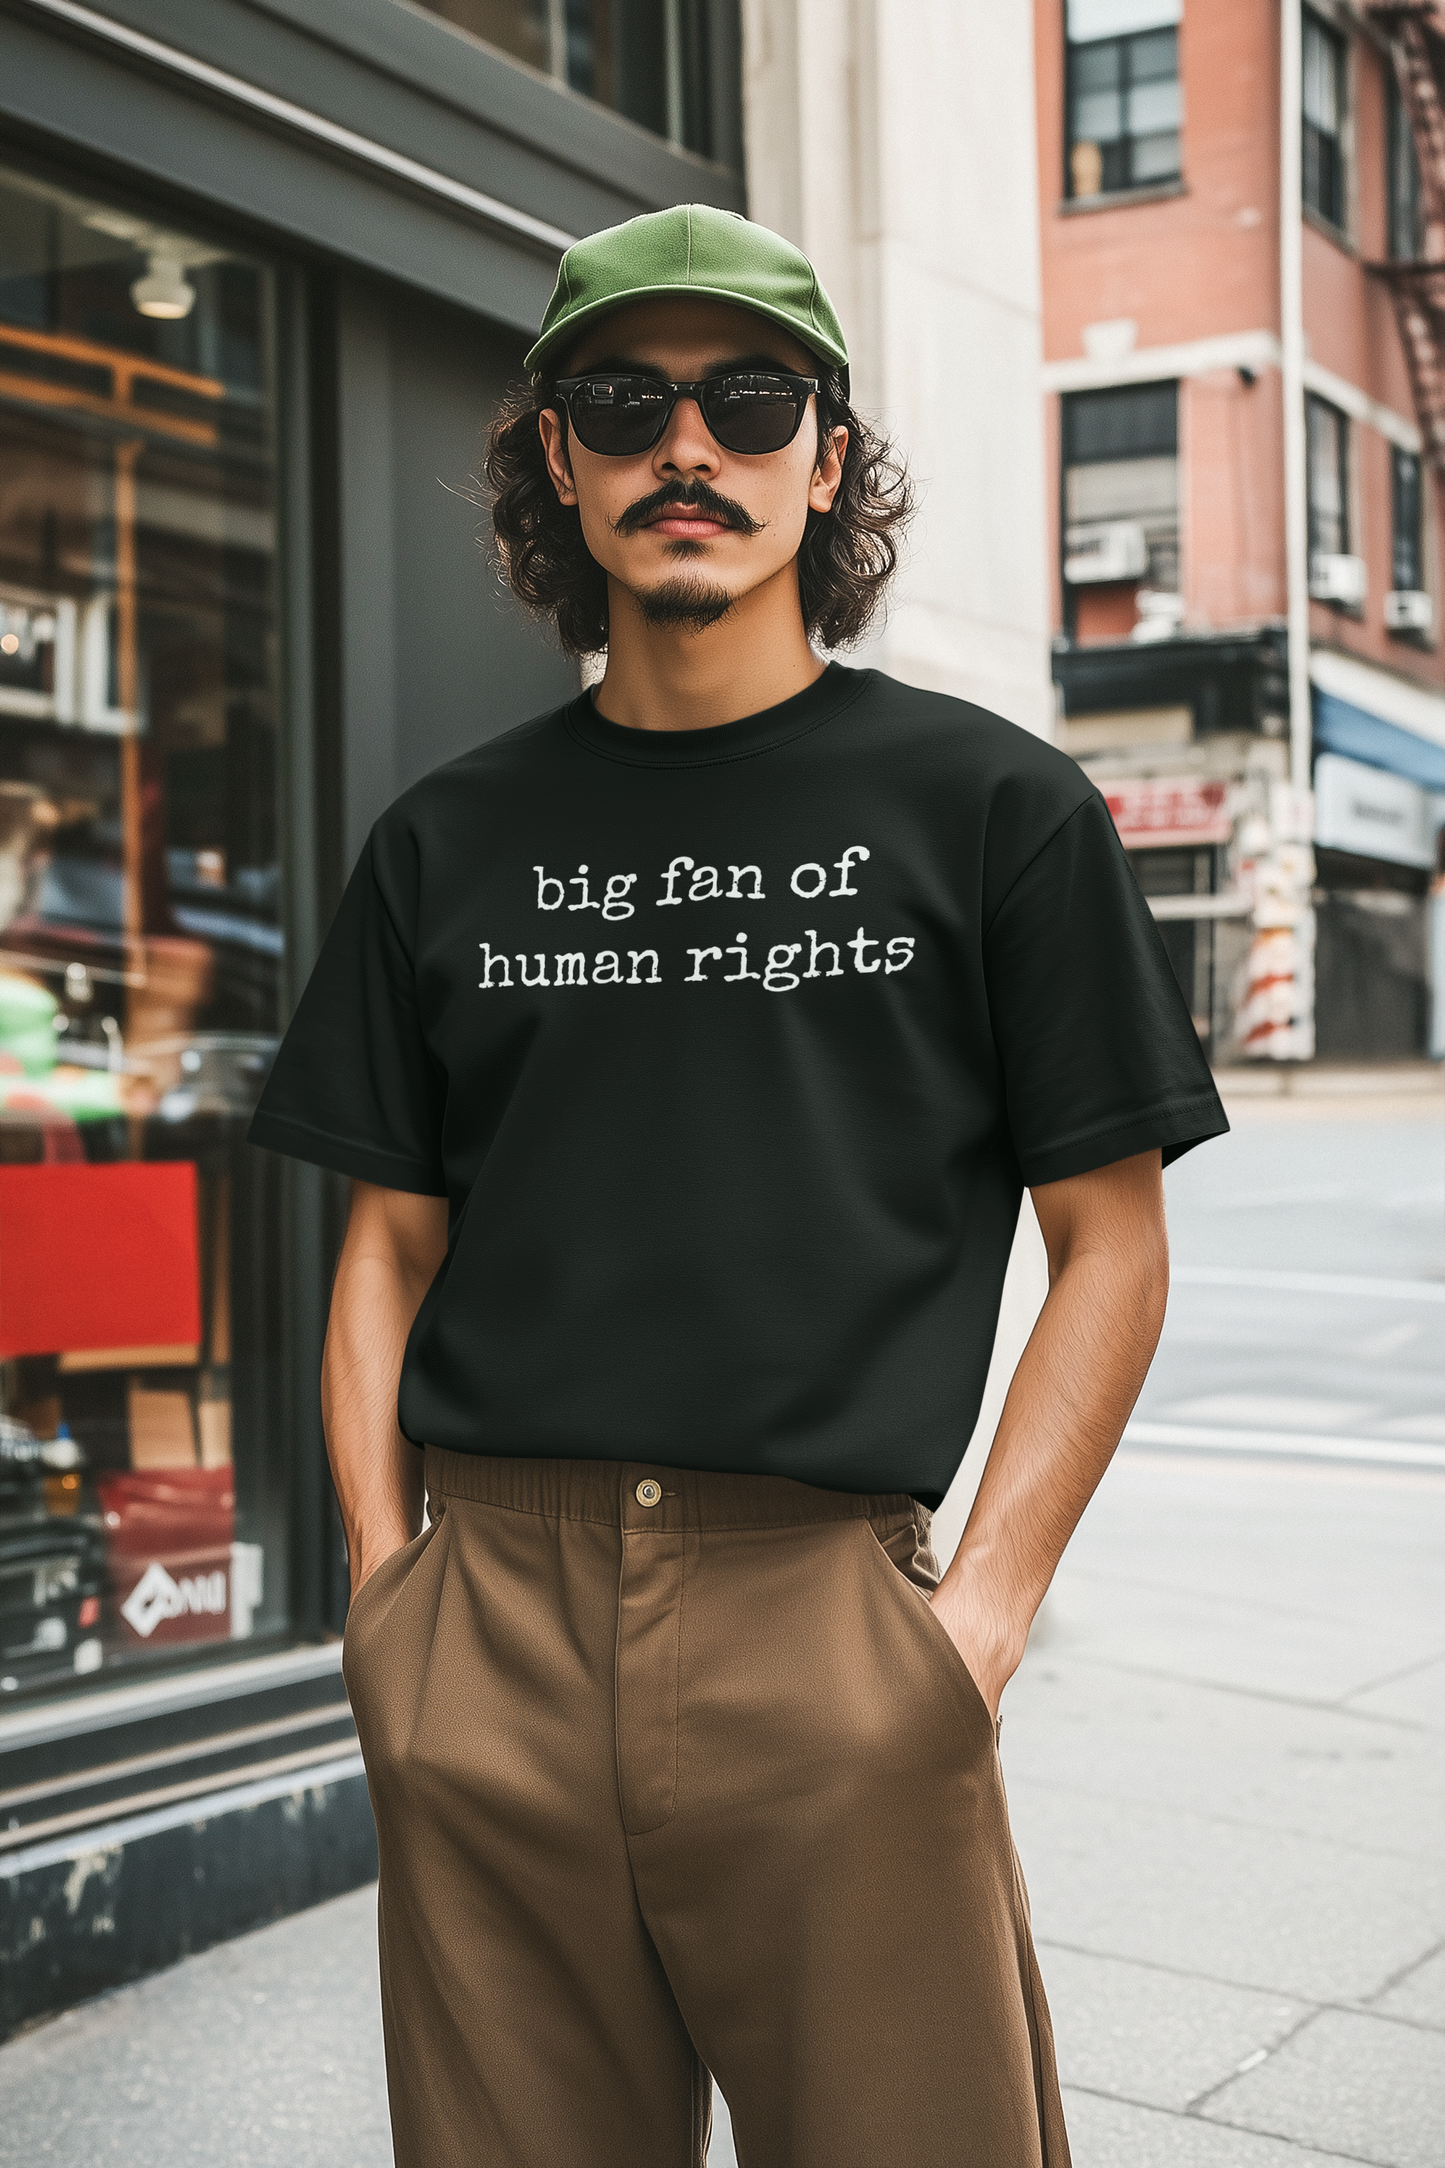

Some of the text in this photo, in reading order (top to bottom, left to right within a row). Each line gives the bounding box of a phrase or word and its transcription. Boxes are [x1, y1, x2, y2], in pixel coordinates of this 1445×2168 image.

[533, 845, 870, 921] big fan of
[478, 926, 916, 993] human rights
